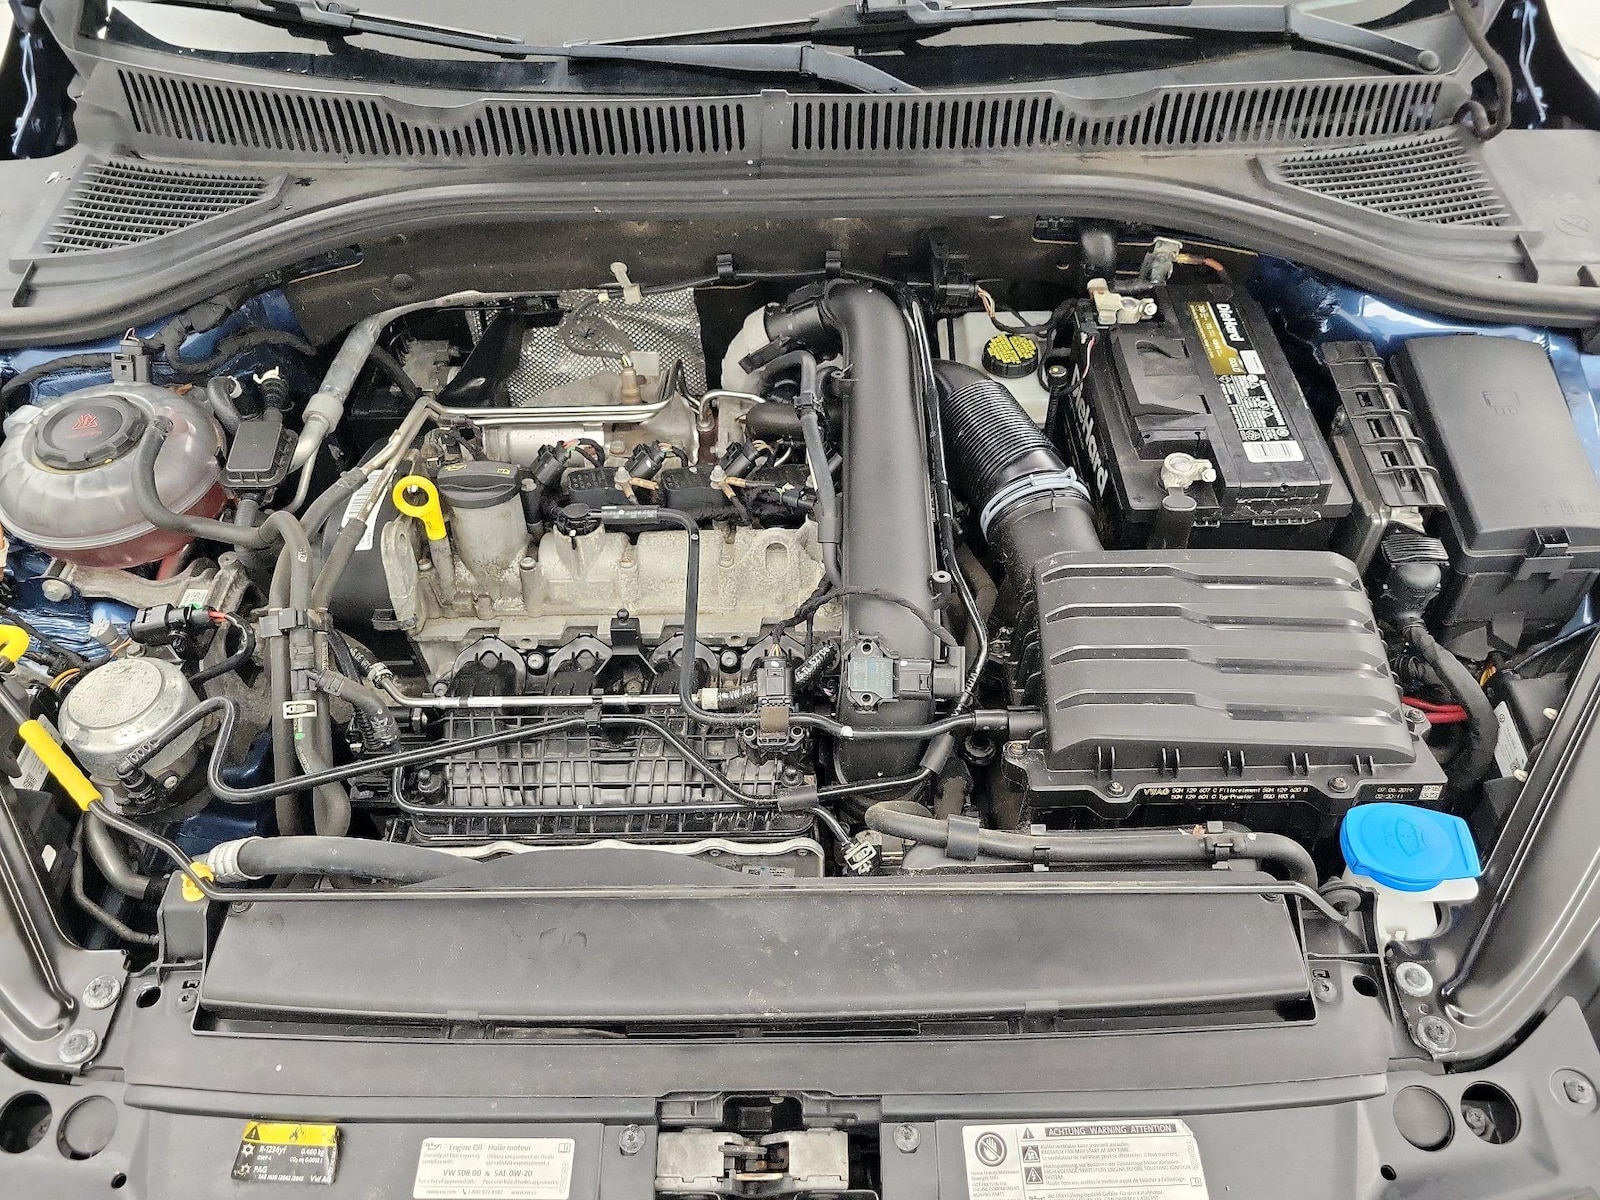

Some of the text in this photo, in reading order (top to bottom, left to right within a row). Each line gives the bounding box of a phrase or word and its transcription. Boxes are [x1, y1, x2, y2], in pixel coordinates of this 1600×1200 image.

[1216, 303, 1245, 341] DieHard
[1228, 357, 1240, 372] GOLD
[1048, 1124, 1172, 1136] ACHTUNG WARNING ATTENTION
[259, 1145, 288, 1156] R-1234yf
[449, 1144, 472, 1152] Engine
[253, 1165, 268, 1174] PAG
[494, 1169, 507, 1177] SAE
[310, 1175, 332, 1184] VW AG
